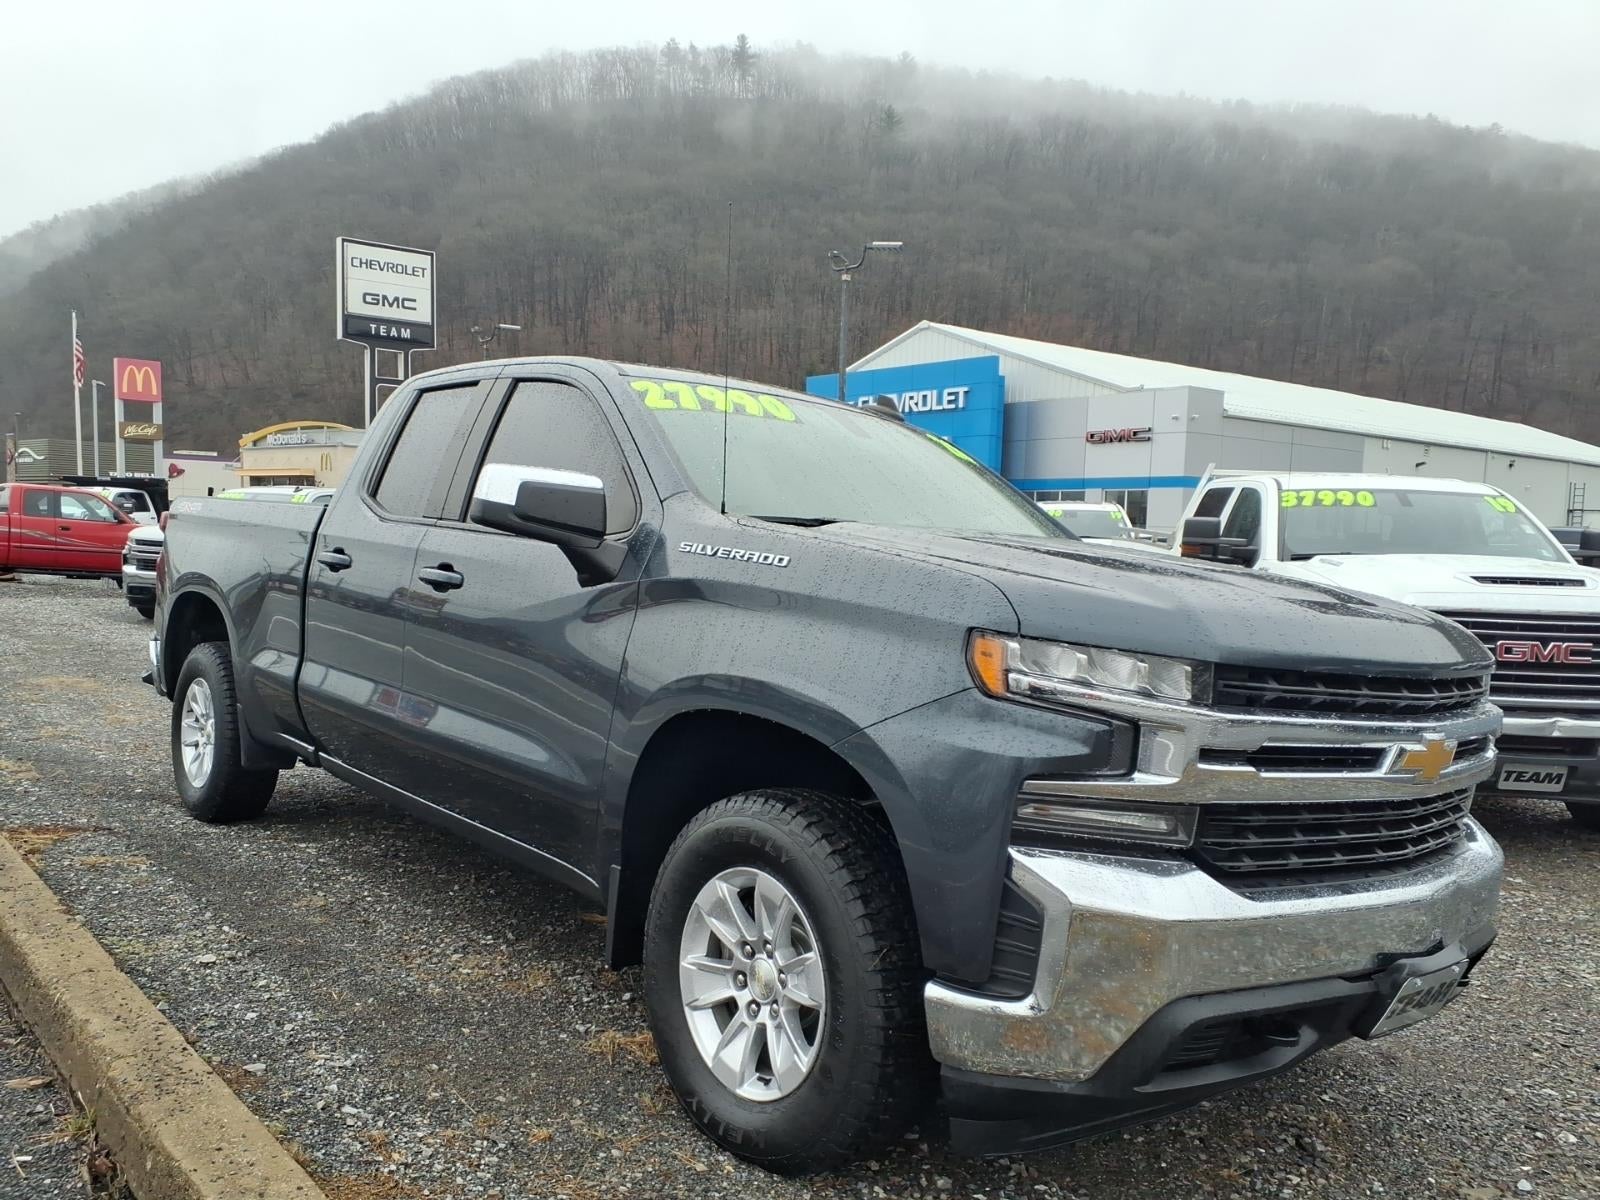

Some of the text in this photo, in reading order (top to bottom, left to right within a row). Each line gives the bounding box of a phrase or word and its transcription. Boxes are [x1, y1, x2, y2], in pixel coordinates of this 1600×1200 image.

[350, 256, 427, 278] CHEVROLET
[362, 292, 417, 311] GMC
[369, 323, 411, 339] TEAM
[629, 380, 796, 421] 27990
[1086, 427, 1152, 444] GMC
[1281, 490, 1375, 507] 37990
[678, 541, 791, 568] SILVERADO
[1496, 640, 1594, 664] GMC
[1502, 769, 1564, 786] TEAM
